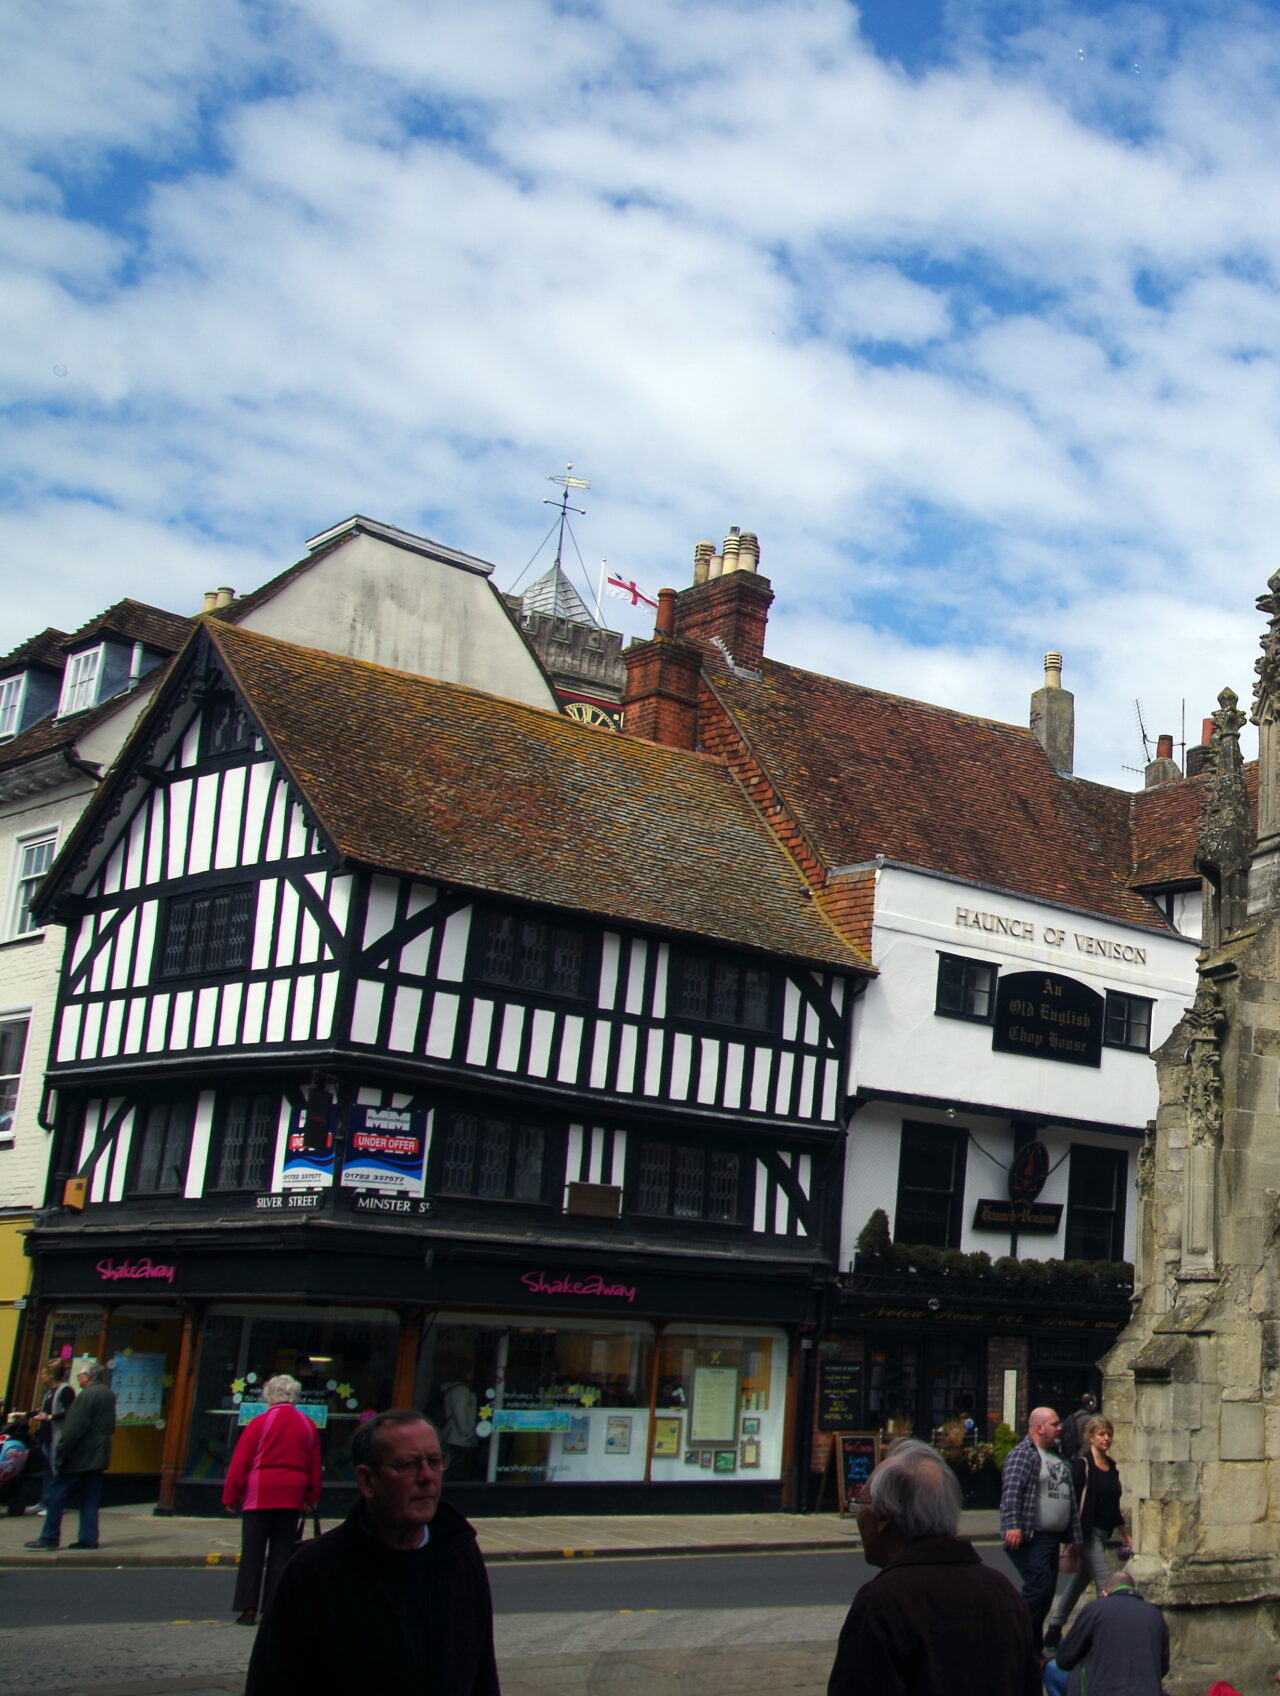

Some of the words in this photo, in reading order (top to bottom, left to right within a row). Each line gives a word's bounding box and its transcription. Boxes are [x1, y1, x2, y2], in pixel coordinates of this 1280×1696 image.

[955, 906, 1034, 941] HAUNCH
[1044, 927, 1065, 947] OF
[1074, 933, 1147, 965] VENISON
[1042, 978, 1063, 997] An
[1009, 999, 1035, 1017] Old
[1039, 1003, 1091, 1030] English
[1008, 1026, 1043, 1048] Chop
[1048, 1032, 1089, 1053] House
[358, 1136, 387, 1148] UNDER
[388, 1139, 416, 1150] OFFER
[256, 1197, 283, 1208] SILVER
[288, 1195, 318, 1207] STREET
[358, 1198, 411, 1212] MINSTER
